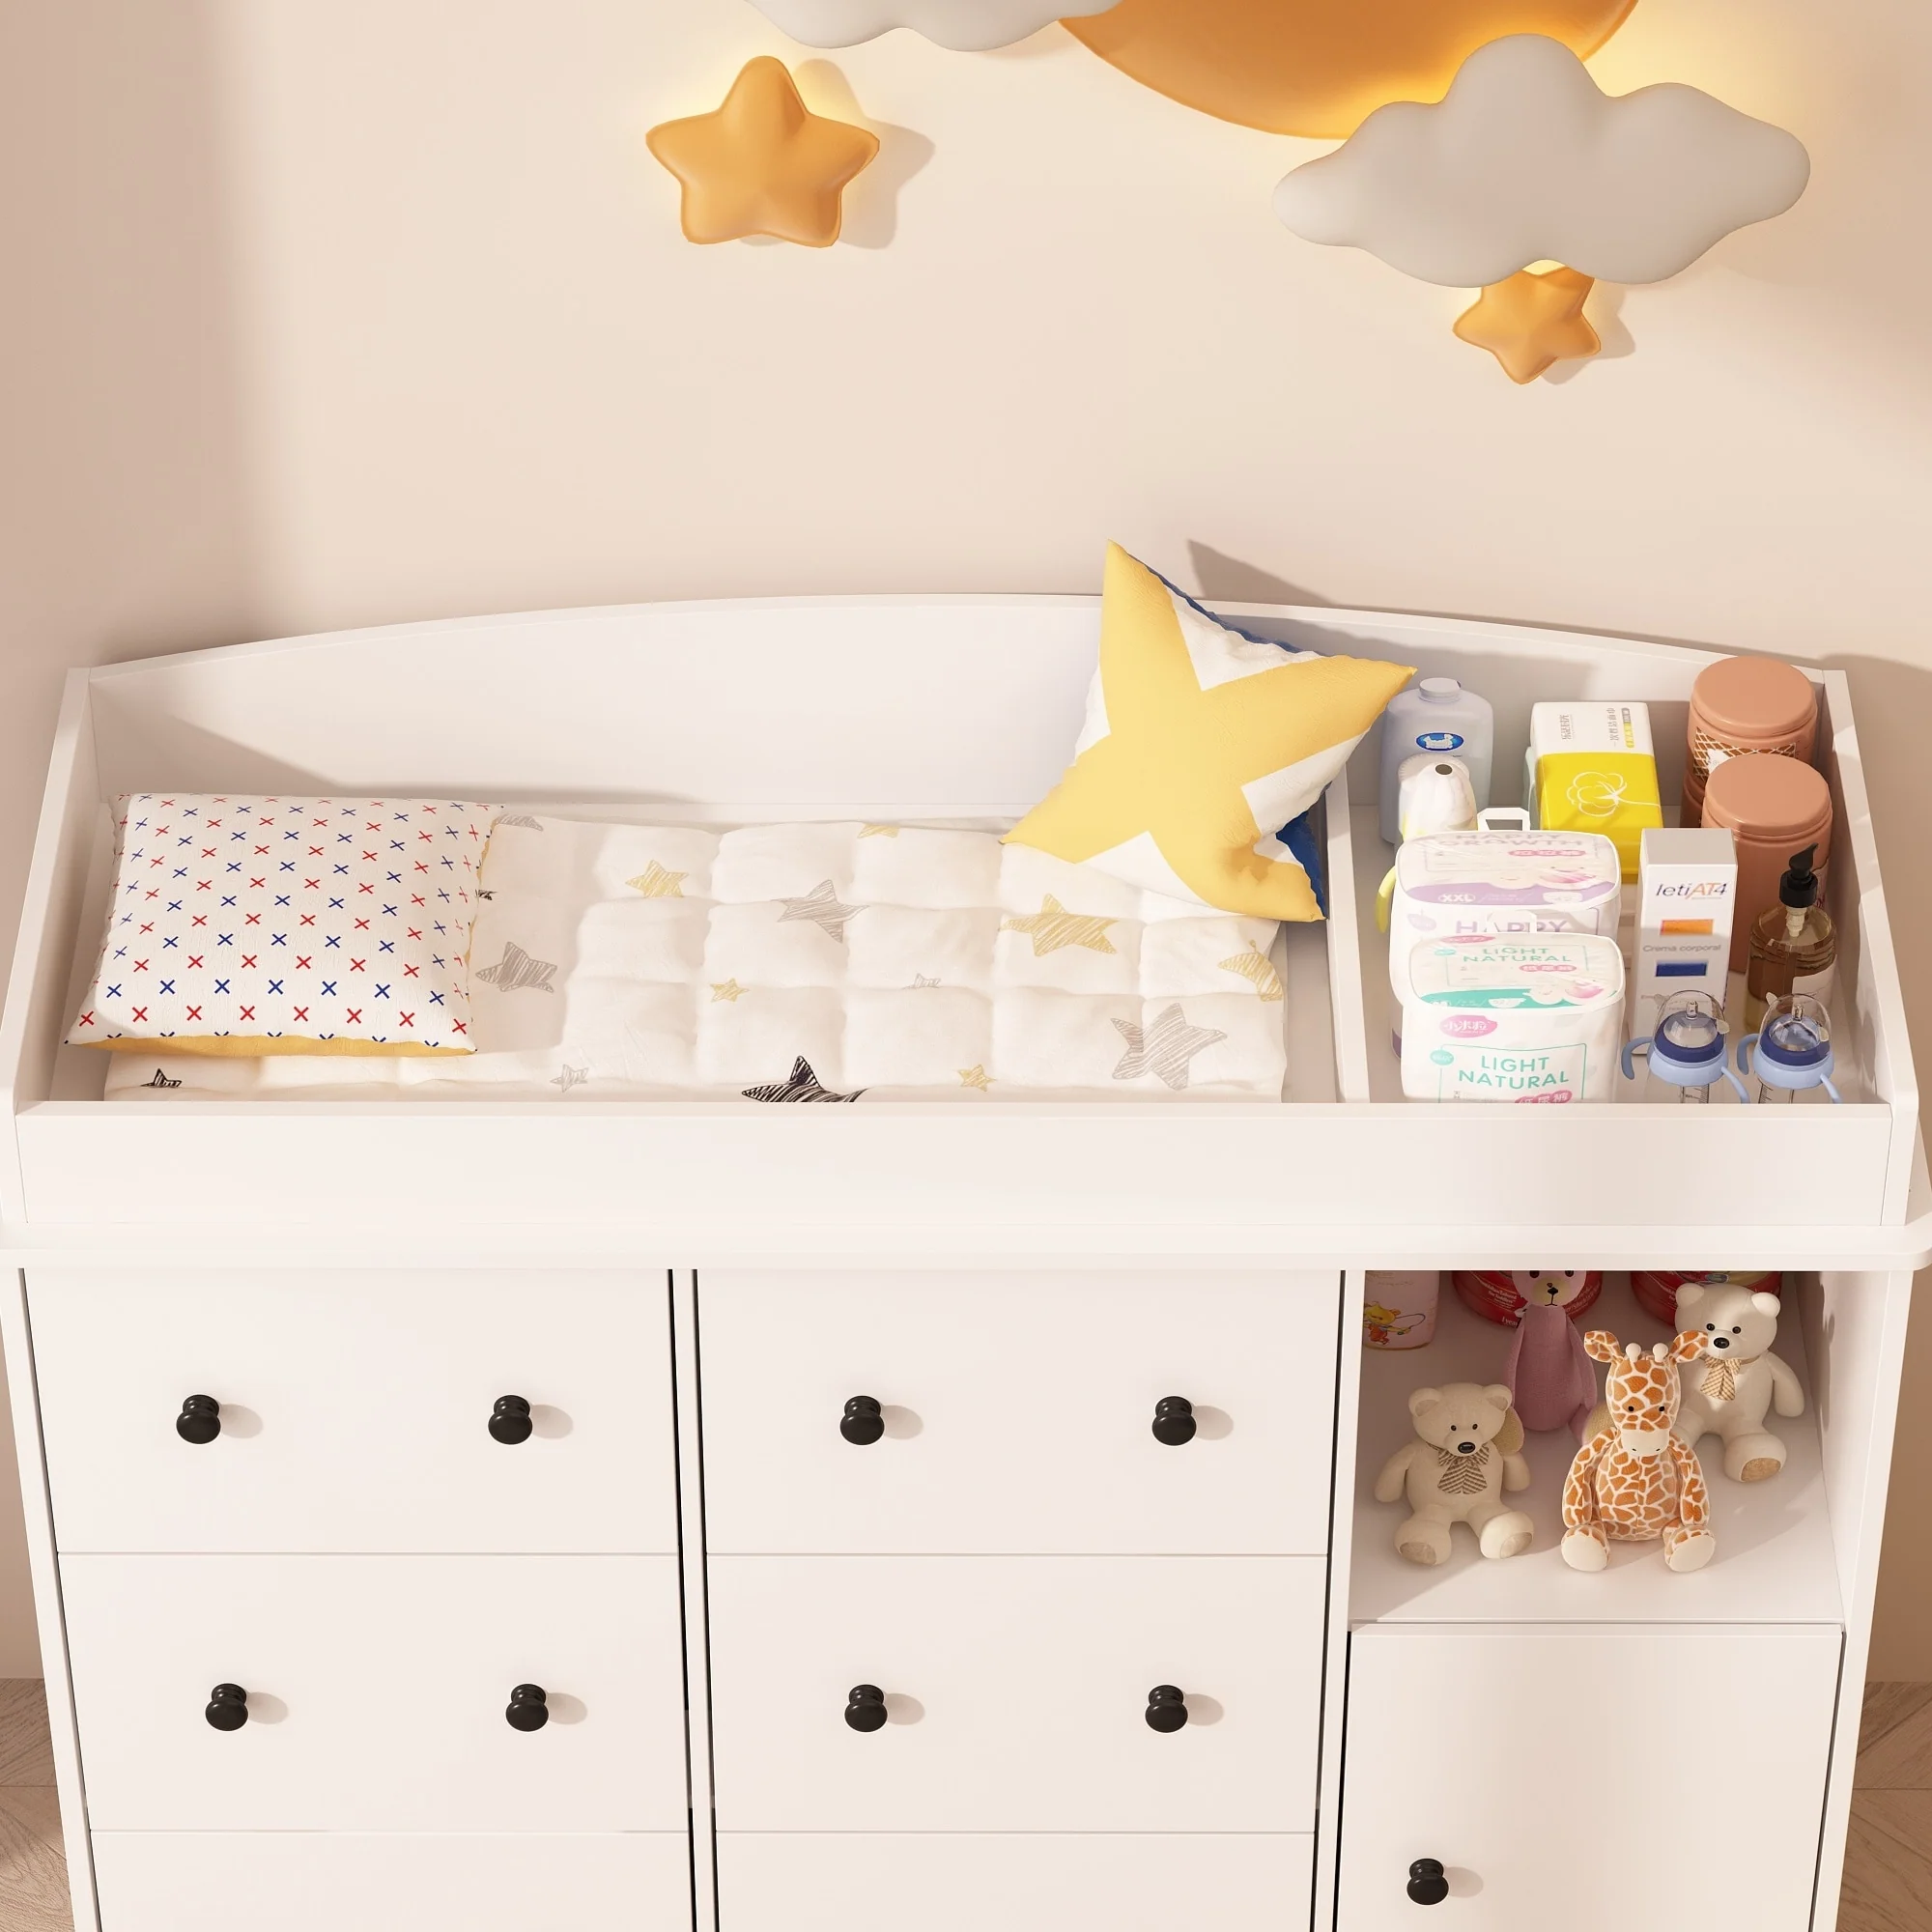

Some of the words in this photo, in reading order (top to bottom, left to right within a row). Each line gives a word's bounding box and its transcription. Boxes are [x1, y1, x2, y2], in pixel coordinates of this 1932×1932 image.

[1441, 894, 1474, 903] XXL
[1482, 947, 1549, 955] LIGHT
[1642, 944, 1678, 952] Crema
[1679, 943, 1722, 953] corporal
[1481, 1055, 1550, 1073] LIGHT
[1459, 1069, 1570, 1090] NATURAL
